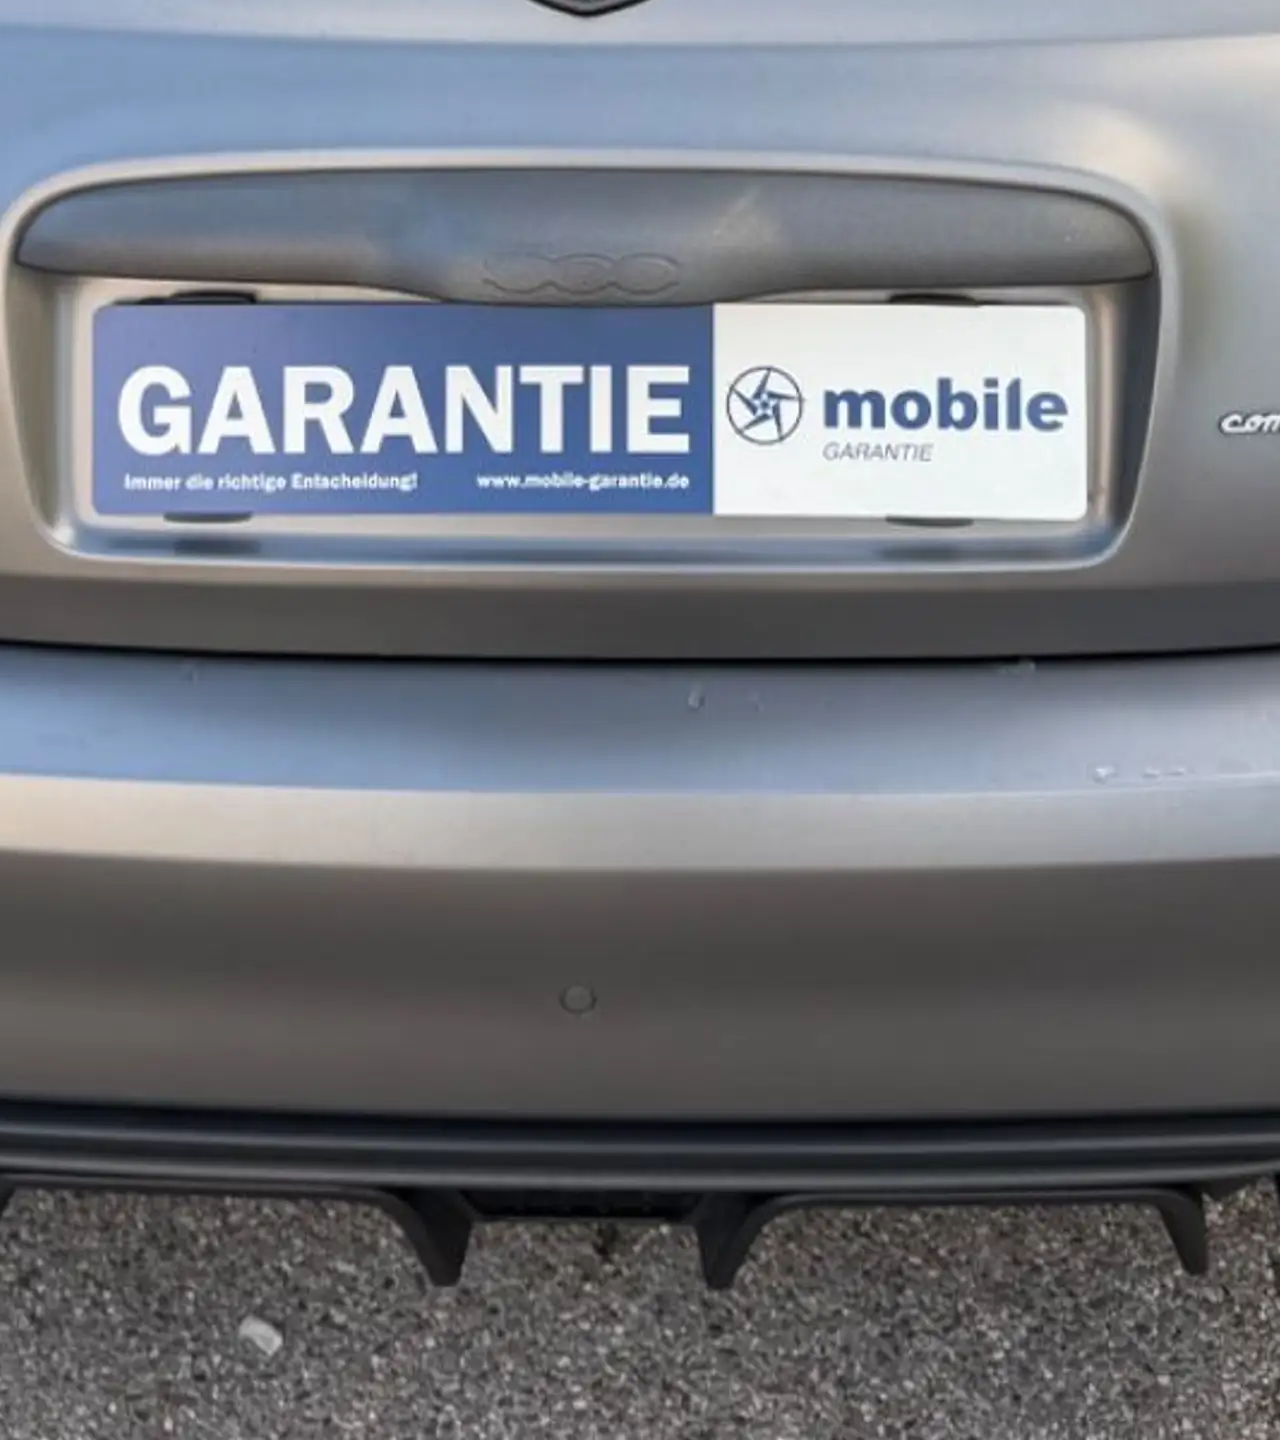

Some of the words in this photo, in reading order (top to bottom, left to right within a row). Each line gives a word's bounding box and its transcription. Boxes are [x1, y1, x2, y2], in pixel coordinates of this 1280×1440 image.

[118, 364, 690, 455] GARANTIE
[823, 377, 1068, 432] mobile
[822, 442, 932, 462] GARANTIE
[124, 472, 180, 491] Immer
[185, 472, 214, 491] die
[218, 471, 286, 493] richtige
[291, 471, 418, 492] Entscheidung!
[476, 471, 690, 492] www.mobile-garantie.de
